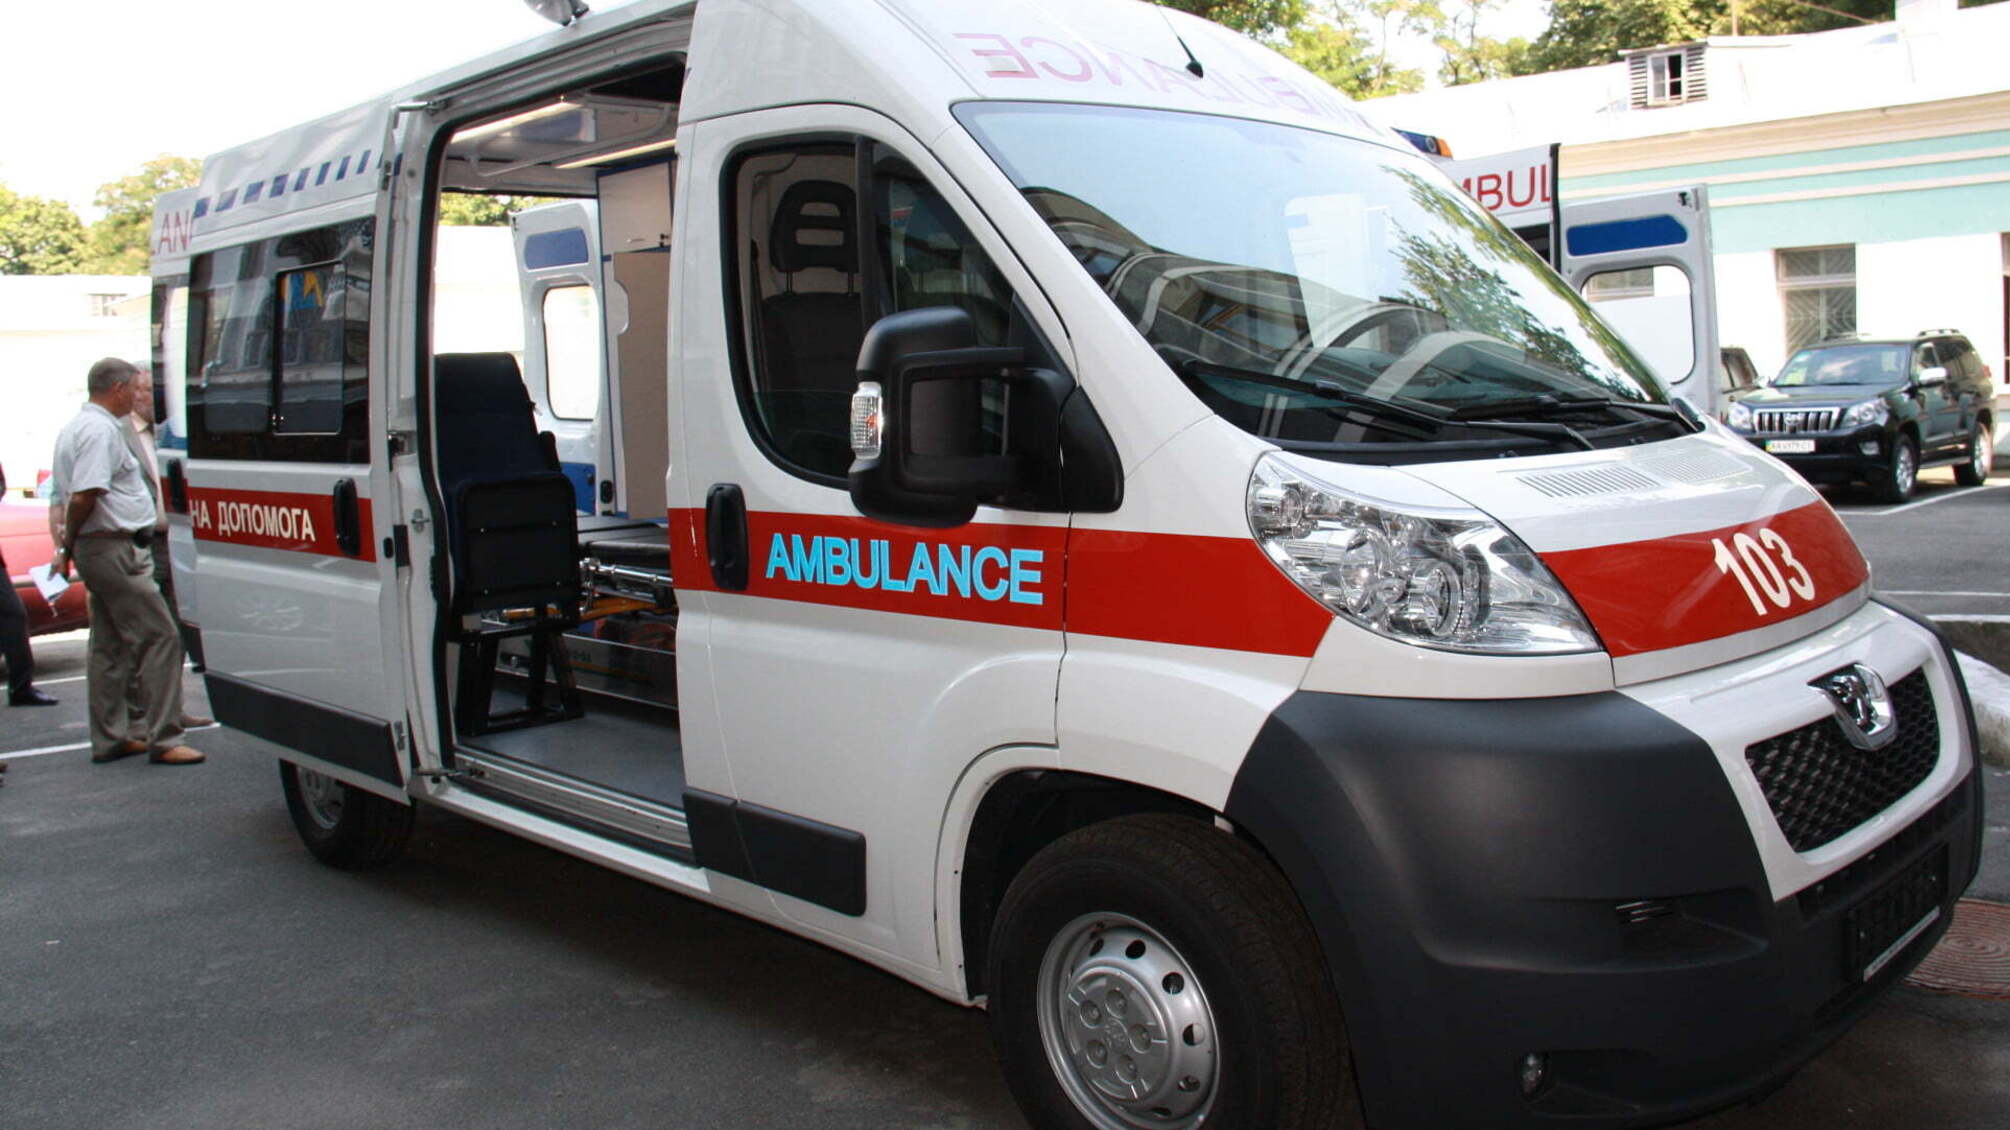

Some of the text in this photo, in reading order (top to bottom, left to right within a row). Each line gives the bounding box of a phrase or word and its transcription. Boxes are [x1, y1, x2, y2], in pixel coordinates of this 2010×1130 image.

[218, 501, 316, 542] ДОПОМОГА
[765, 533, 1044, 605] AMBULANCE
[1711, 528, 1815, 616] 103
